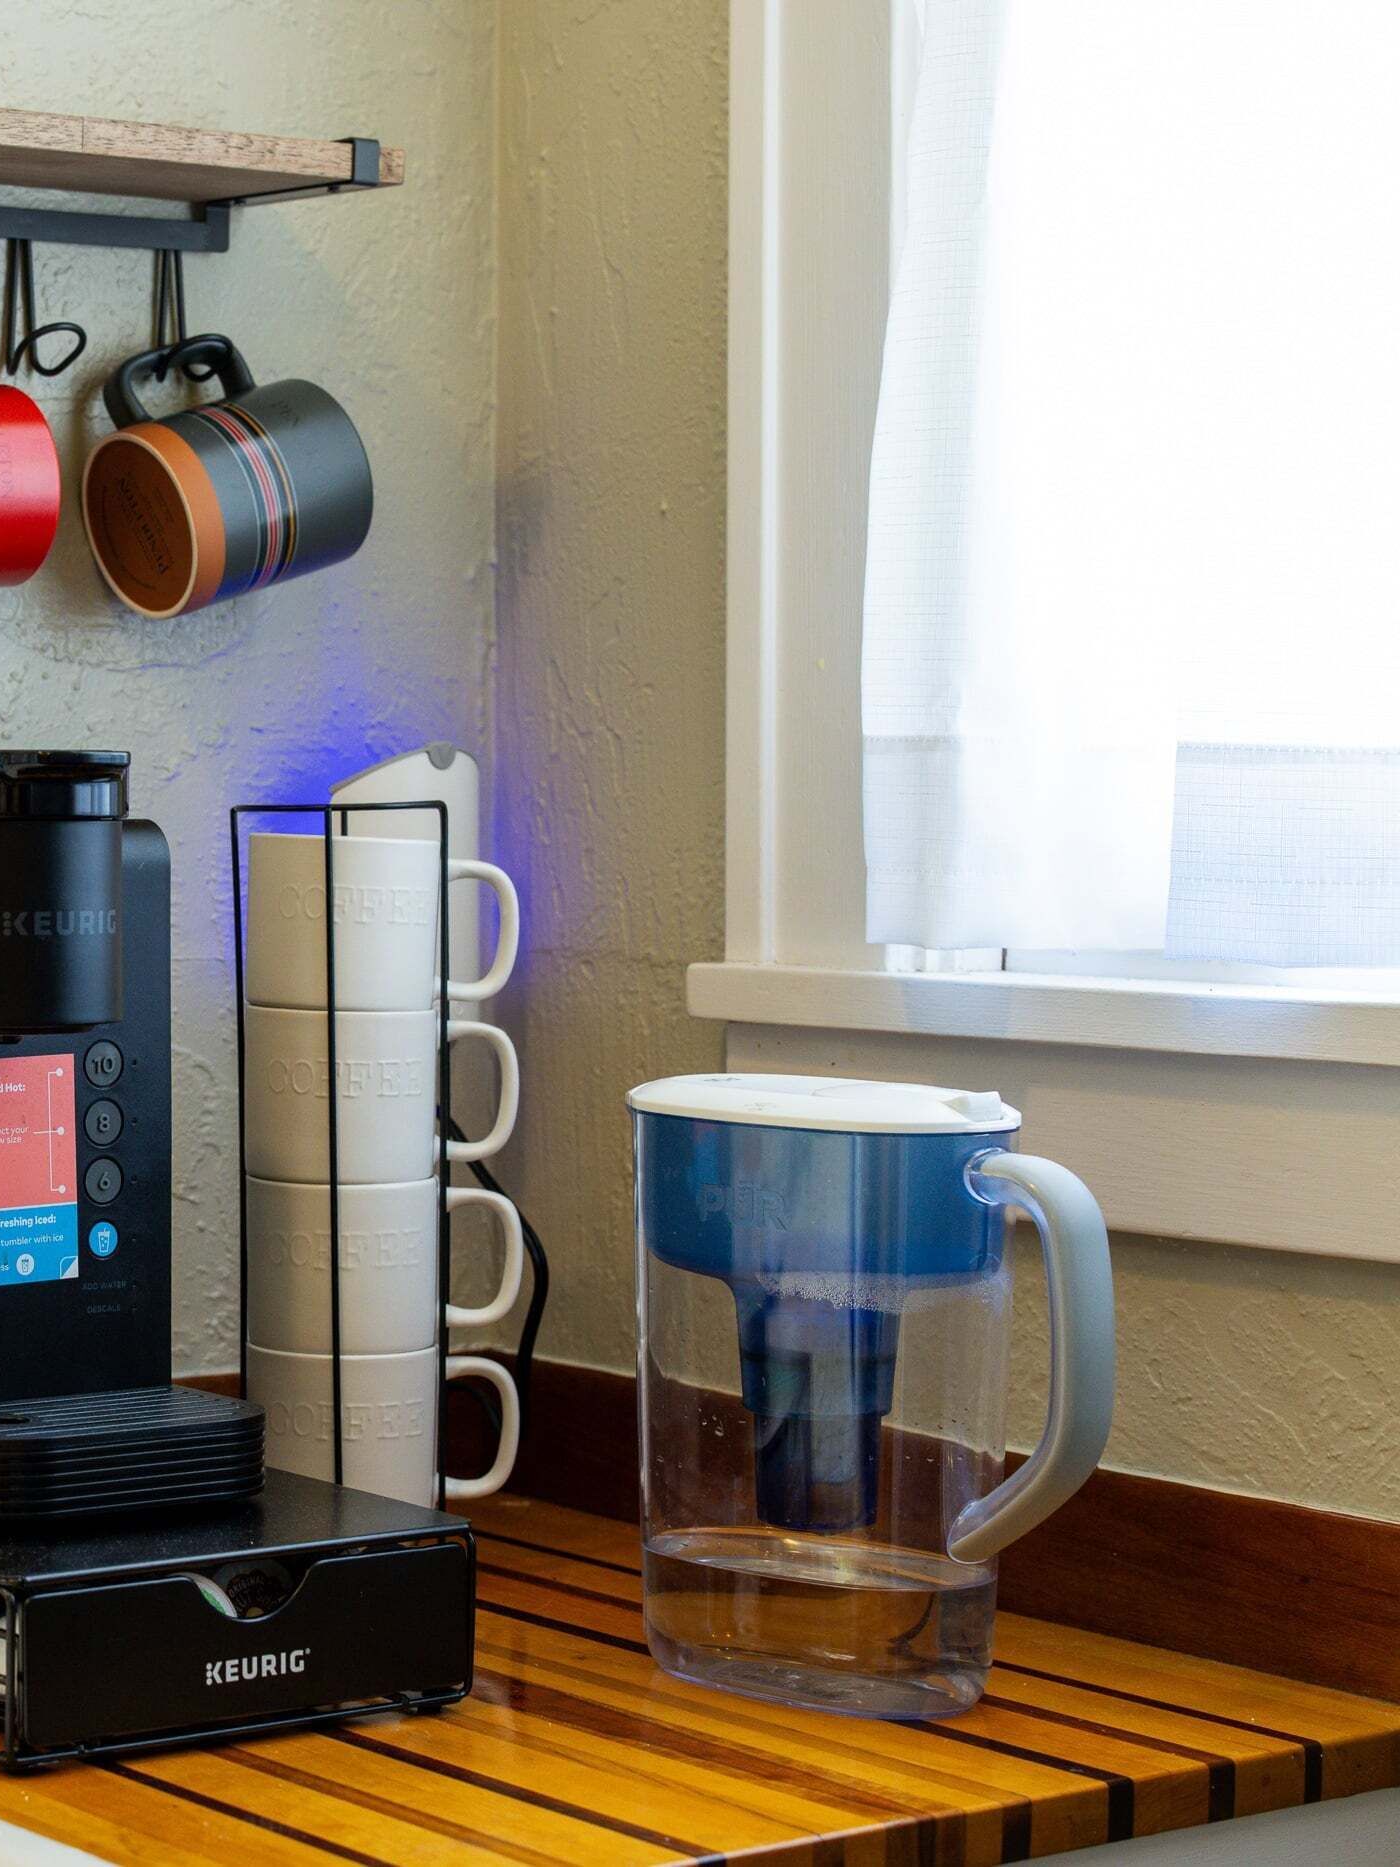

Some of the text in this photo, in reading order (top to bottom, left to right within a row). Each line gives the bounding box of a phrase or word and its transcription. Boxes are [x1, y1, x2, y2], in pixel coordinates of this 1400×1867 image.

[2, 909, 116, 936] KEURIG
[92, 1057, 115, 1074] 10
[5, 1082, 26, 1093] Hot:
[268, 1058, 423, 1099] COFFEE
[98, 1113, 111, 1133] 8
[99, 1171, 111, 1191] 6
[35, 1214, 57, 1225] Iced:
[0, 1235, 31, 1247] tumbler
[33, 1234, 51, 1244] with
[52, 1233, 64, 1243] ice
[206, 1649, 305, 1686] KEURIG
